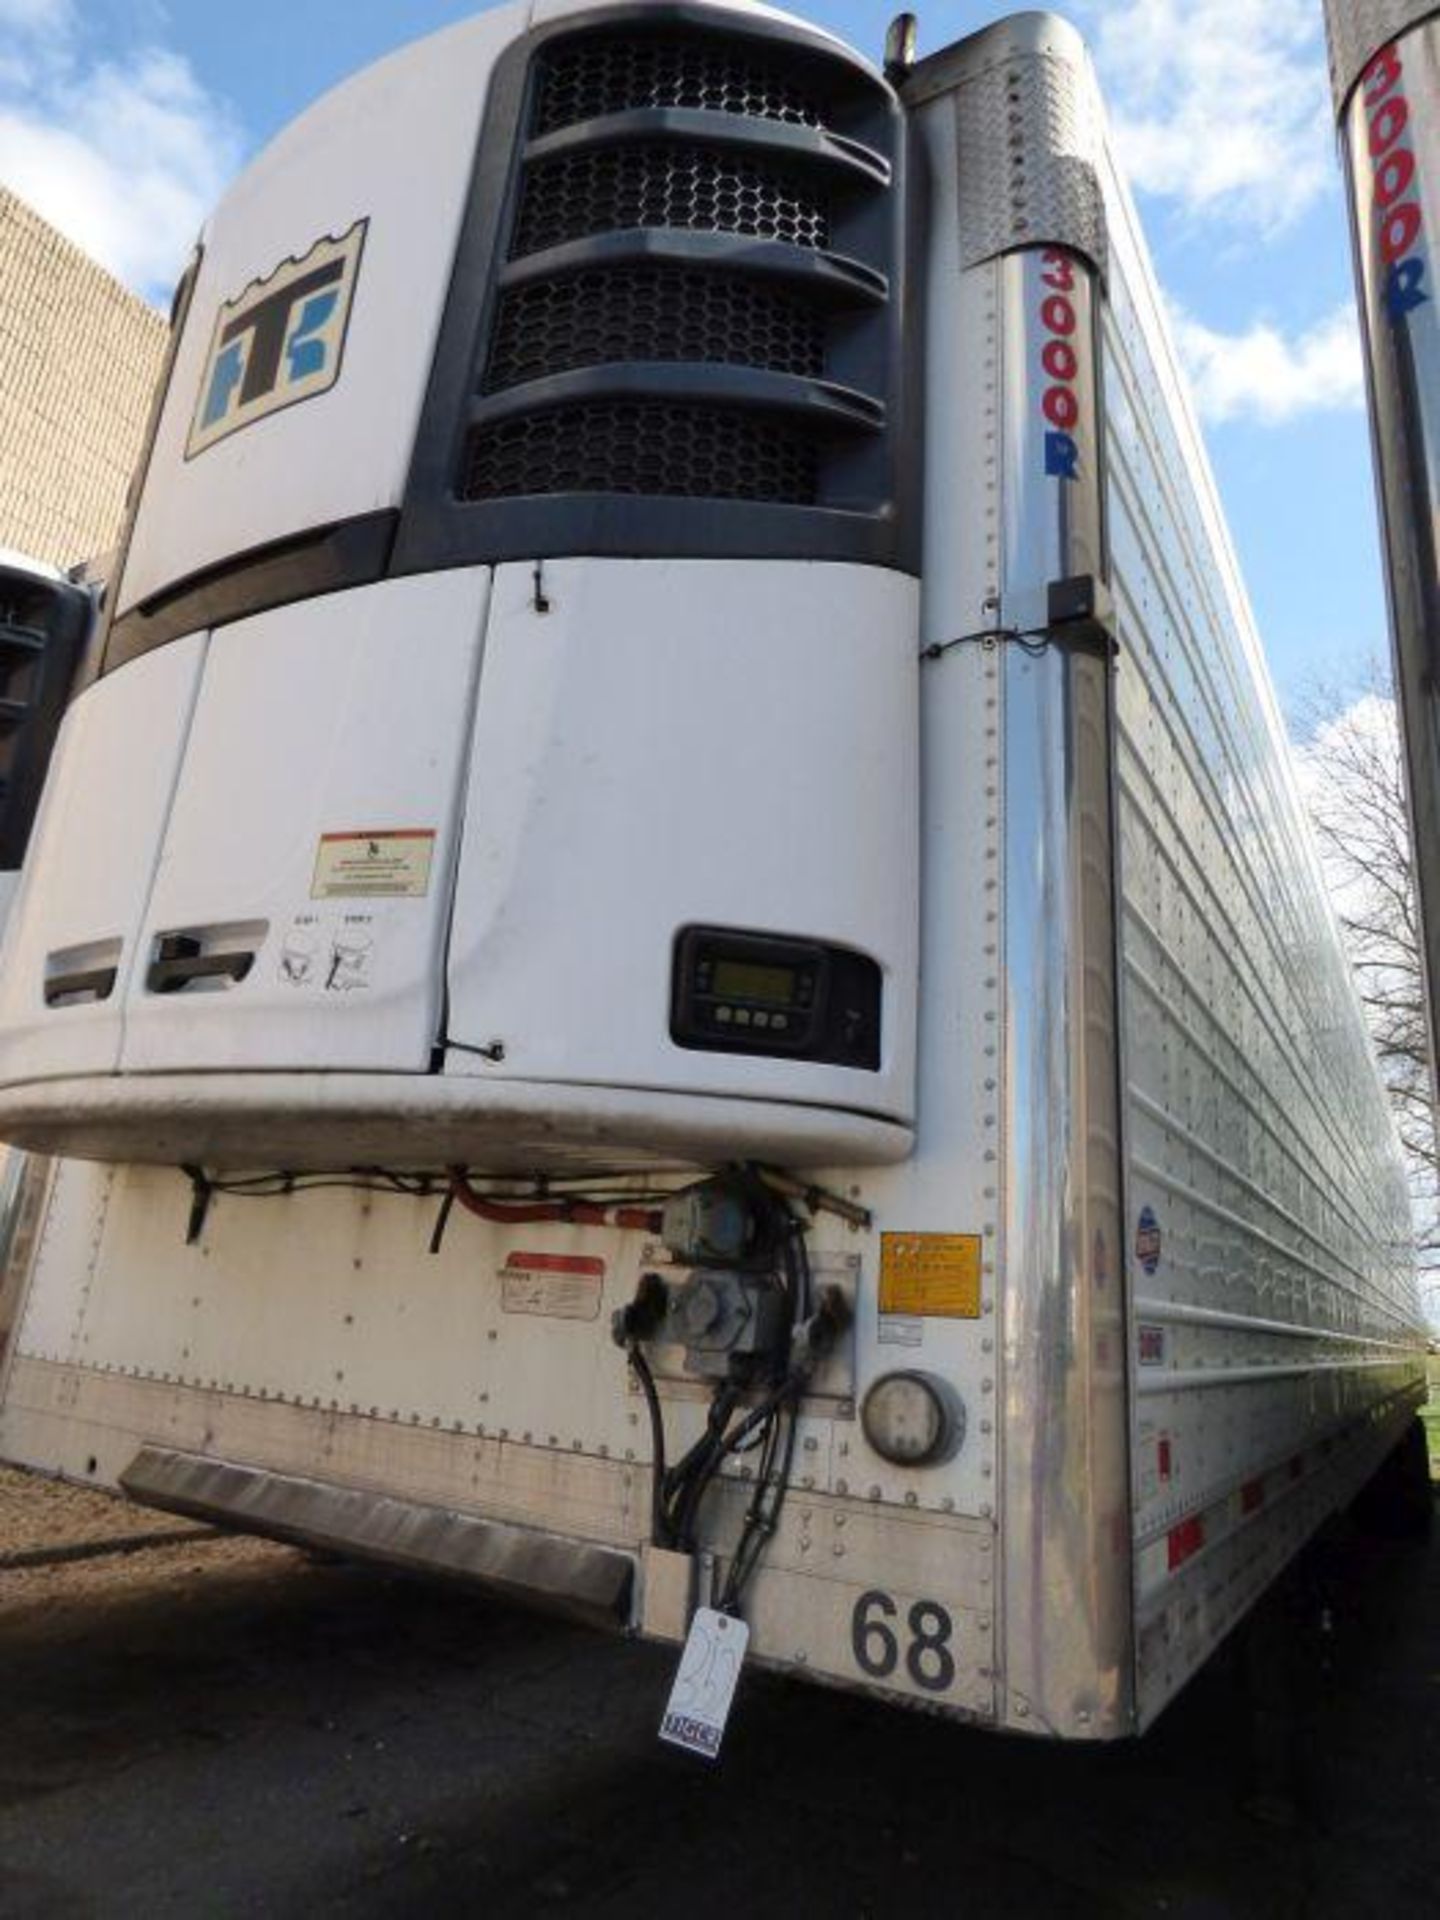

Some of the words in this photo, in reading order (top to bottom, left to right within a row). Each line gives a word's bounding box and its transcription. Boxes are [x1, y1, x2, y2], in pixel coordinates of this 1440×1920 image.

[1363, 42, 1428, 322] 3000R
[1040, 247, 1078, 480] 3000R
[852, 1590, 955, 1692] 68
